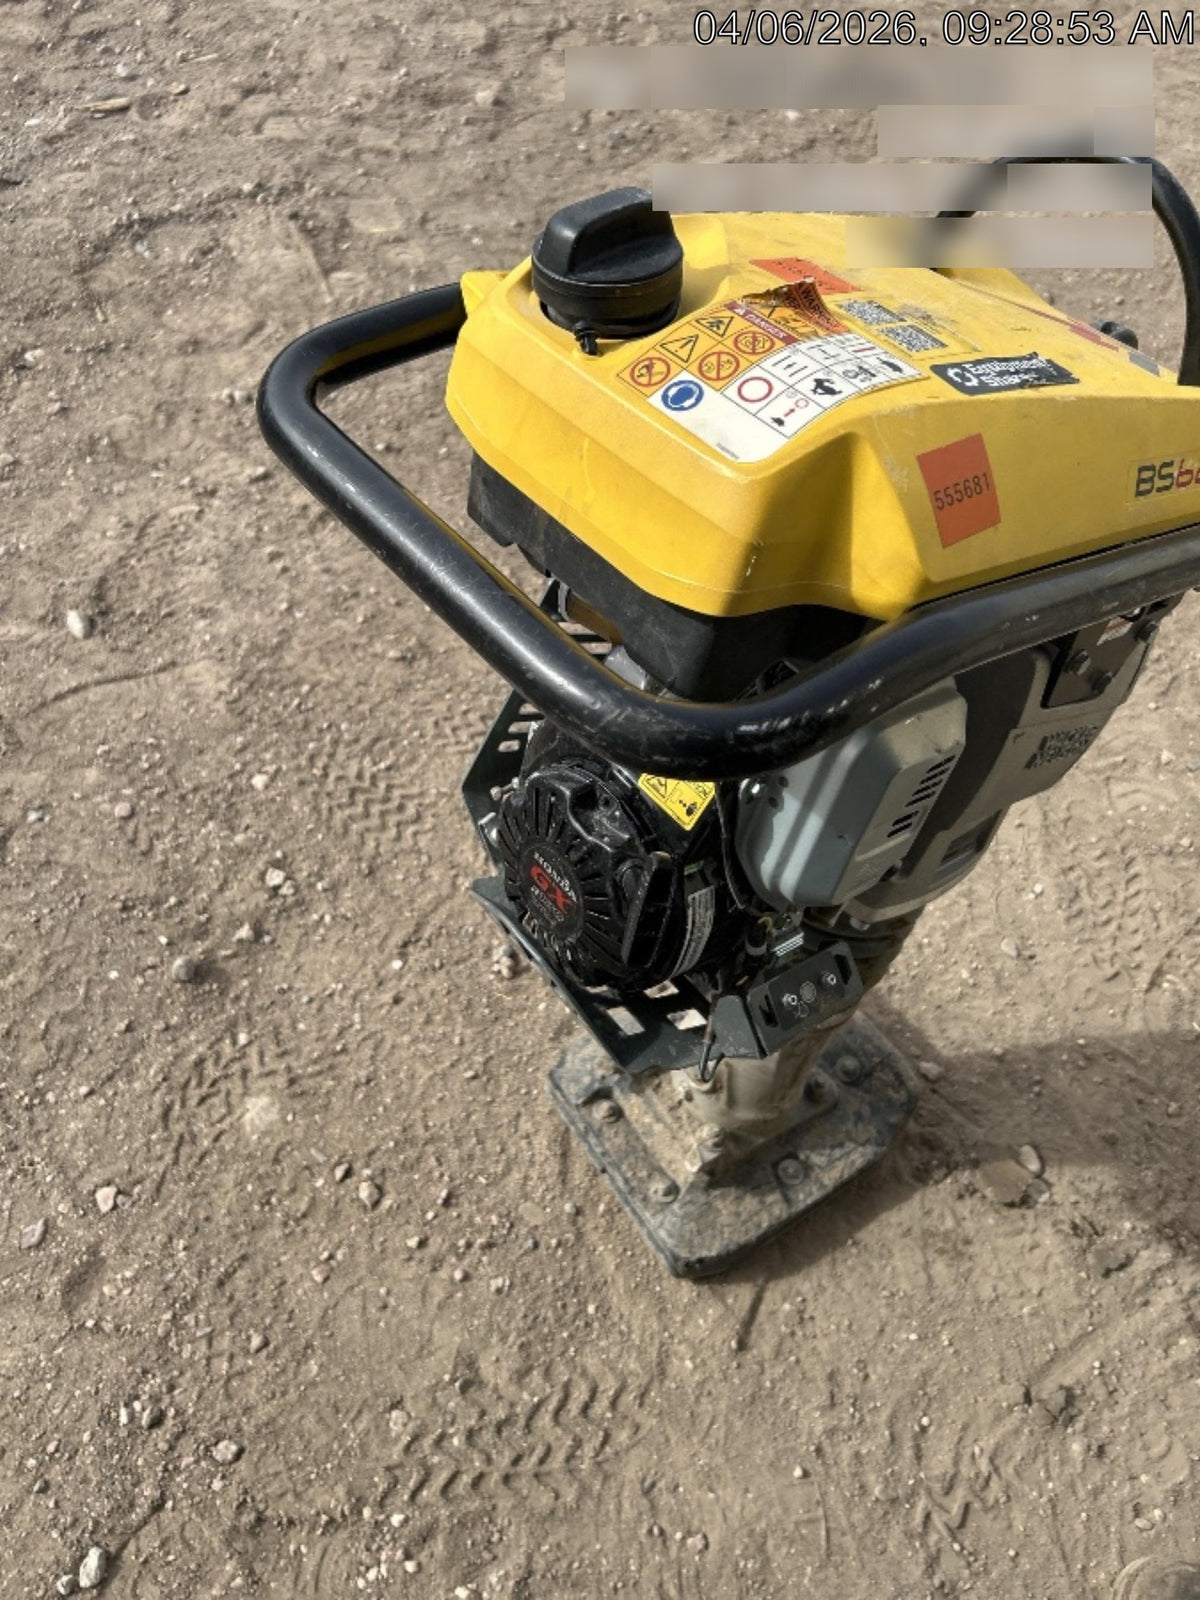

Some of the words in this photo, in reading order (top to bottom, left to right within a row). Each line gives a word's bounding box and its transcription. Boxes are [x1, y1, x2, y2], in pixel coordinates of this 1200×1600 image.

[933, 472, 990, 511] 555681
[1135, 458, 1200, 497] BS6
[529, 864, 574, 915] GX
[533, 851, 577, 903] HONDA
